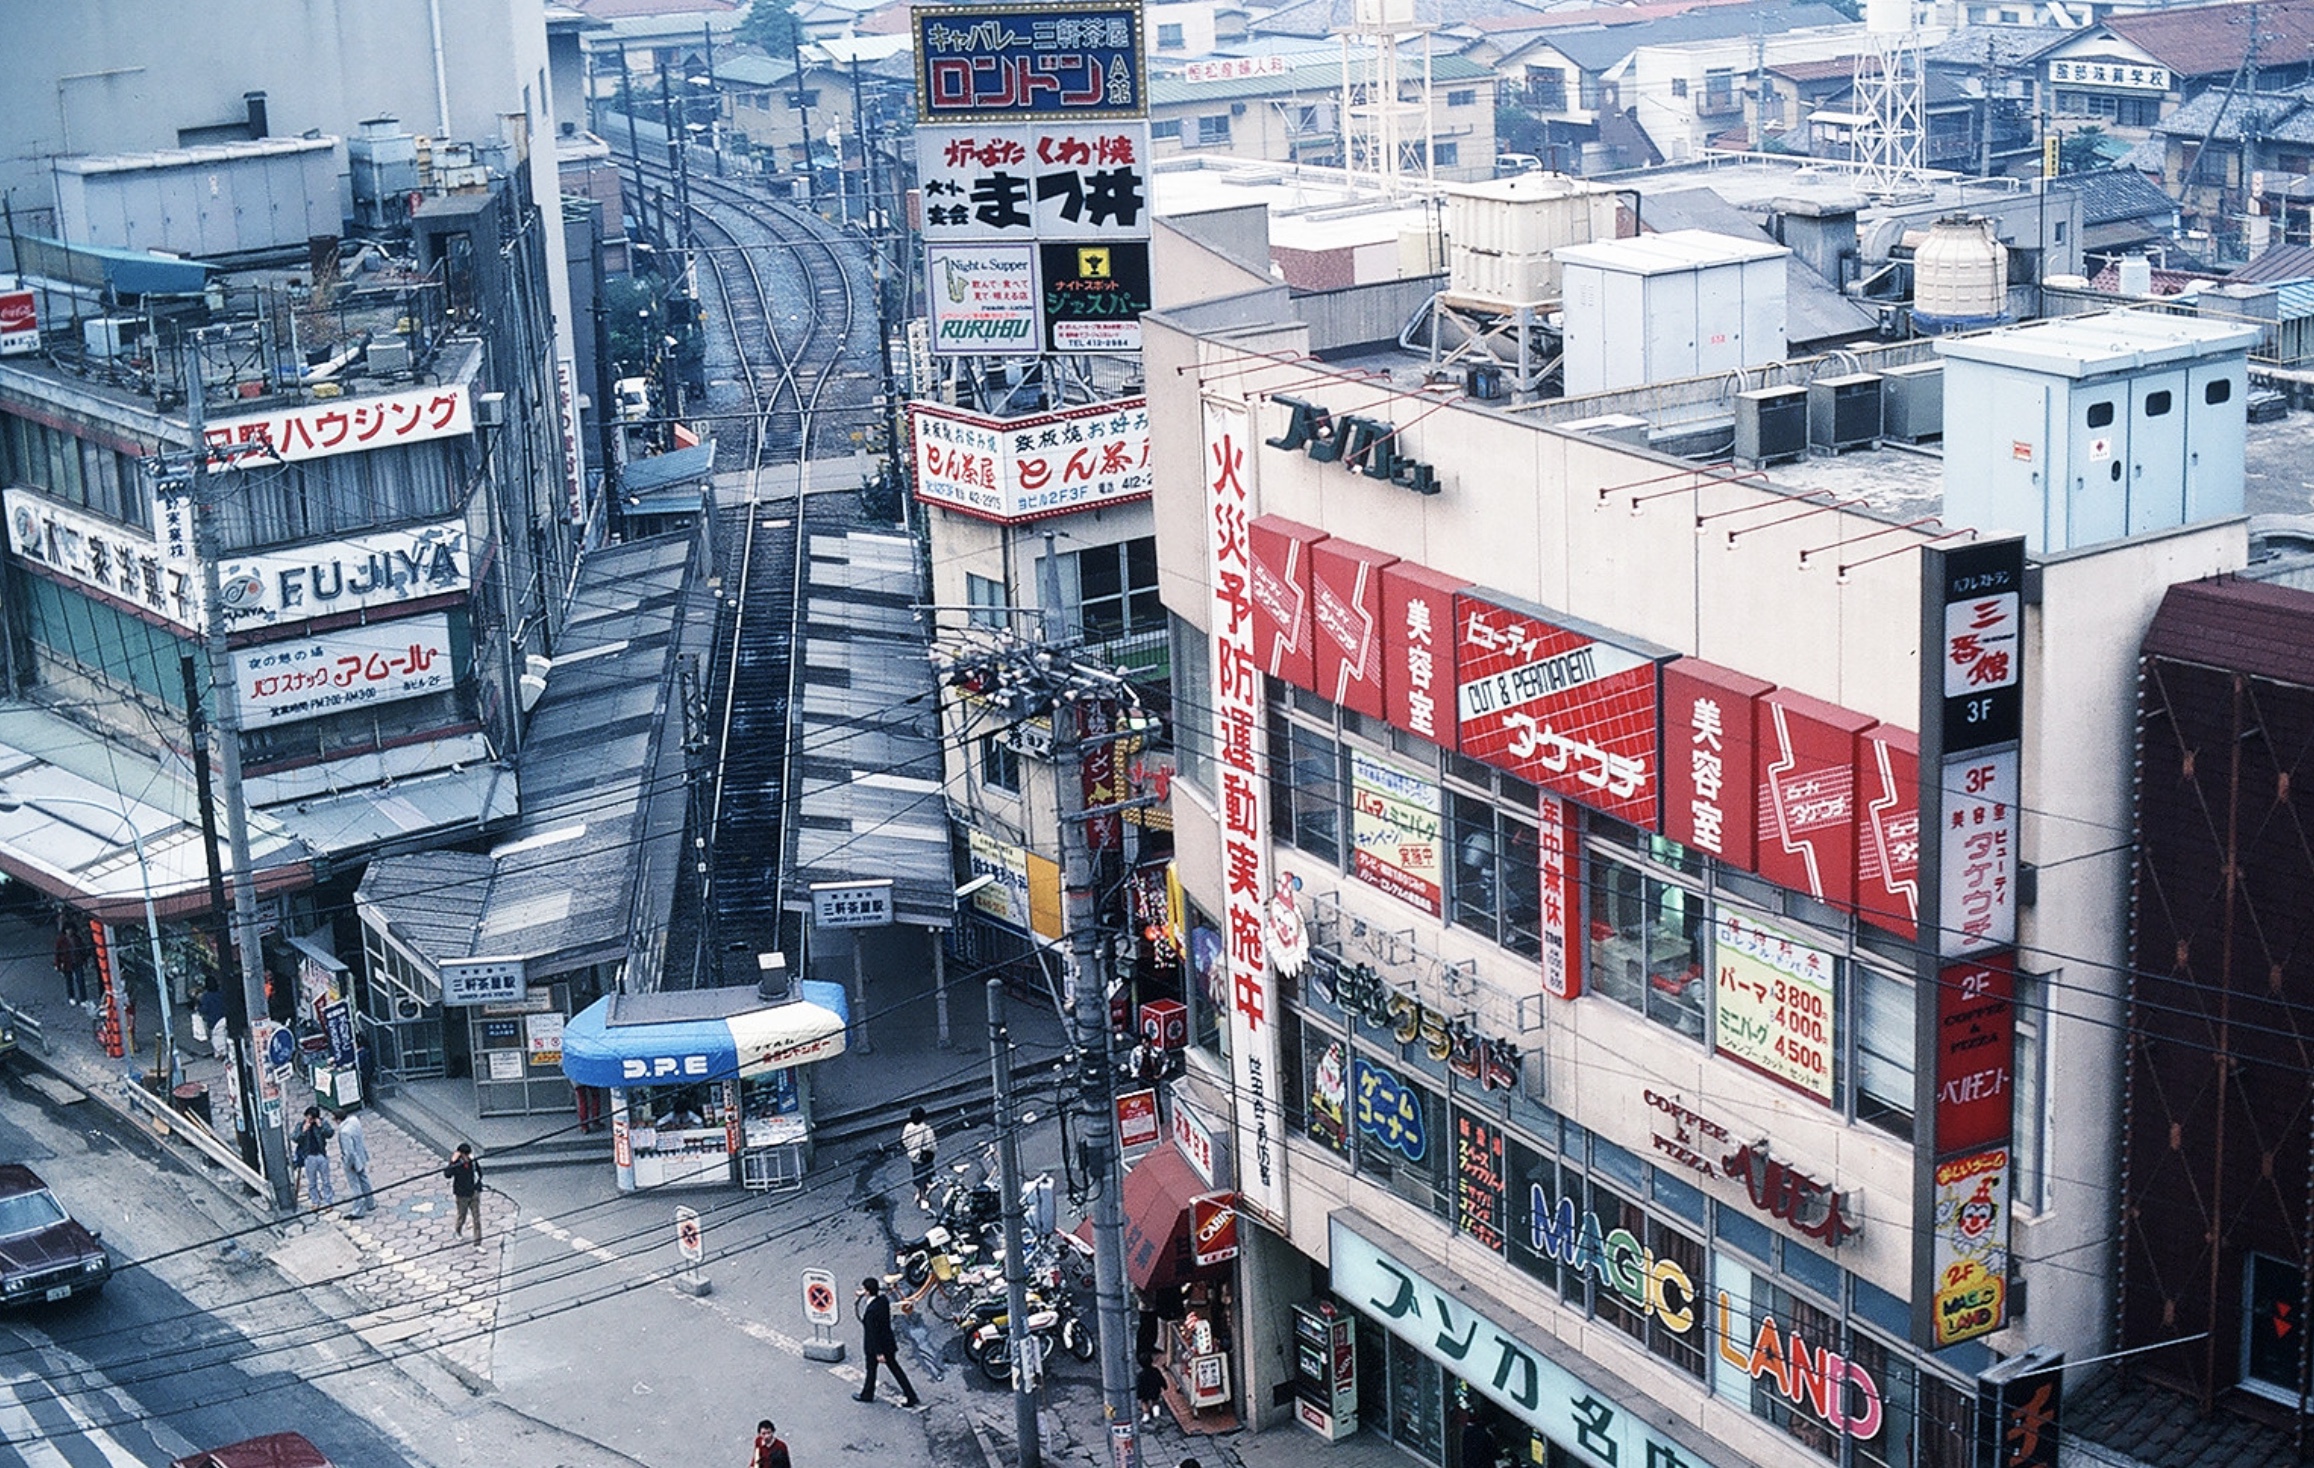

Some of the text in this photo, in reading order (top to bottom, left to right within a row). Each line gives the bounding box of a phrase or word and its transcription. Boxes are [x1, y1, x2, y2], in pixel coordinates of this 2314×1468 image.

[928, 18, 1130, 52] キャバレー三軒茶屋
[929, 54, 1103, 108] ロンドン
[1107, 53, 1132, 105] A館
[2056, 63, 2164, 87] 服部珠算学校
[944, 135, 1136, 168] 炉ばた くわ焼
[928, 204, 969, 226] 宴会
[970, 166, 1144, 229] まつ井
[950, 260, 979, 273] Night
[989, 259, 1028, 272] Supper
[1055, 280, 1119, 291] ナイトスポット
[1068, 339, 1084, 347] TEL
[204, 392, 458, 465] 日野ハウジング
[926, 442, 997, 491] とん茶屋
[42, 516, 186, 620] 不二家洋菓子
[278, 542, 461, 609] FUJIYA
[1466, 611, 1539, 663] ビューティ
[251, 667, 328, 699] パブスナック
[334, 643, 438, 687] アムール
[1405, 598, 1436, 738] 美容室
[1468, 646, 1598, 715] CUT & PERMANENT
[1966, 698, 1993, 723] 3F
[1211, 433, 1265, 1031] 火災予防運動実施中
[1501, 711, 1647, 800] タケウチ
[1691, 697, 1724, 855] 美容室
[1965, 765, 1995, 794] 3F
[1951, 802, 2006, 831] 美容室
[1542, 796, 1563, 928] 年中無休
[1994, 828, 2008, 906] ビューティ
[1963, 831, 1994, 946] タケウチ
[453, 975, 516, 992] 三軒茶屋駅
[1719, 966, 1768, 1005] パーマ
[1961, 971, 1991, 1001] 2F
[1943, 1001, 2008, 1028] COFFEE
[1950, 1031, 2000, 1055] PIZZA
[622, 1055, 709, 1080] D.P.E
[1643, 1088, 1731, 1145] COFFEE
[1675, 1126, 1691, 1145] &
[1651, 1131, 1722, 1181] PIZZA
[1459, 1177, 1494, 1209] ミサイル
[1199, 1204, 1236, 1243] CABIN
[1530, 1182, 1696, 1335] MAGIC
[1946, 1262, 1975, 1289] 2F
[1942, 1285, 1997, 1319] MAGIC
[1946, 1306, 1993, 1337] LAND
[1717, 1290, 1882, 1441] LAND
